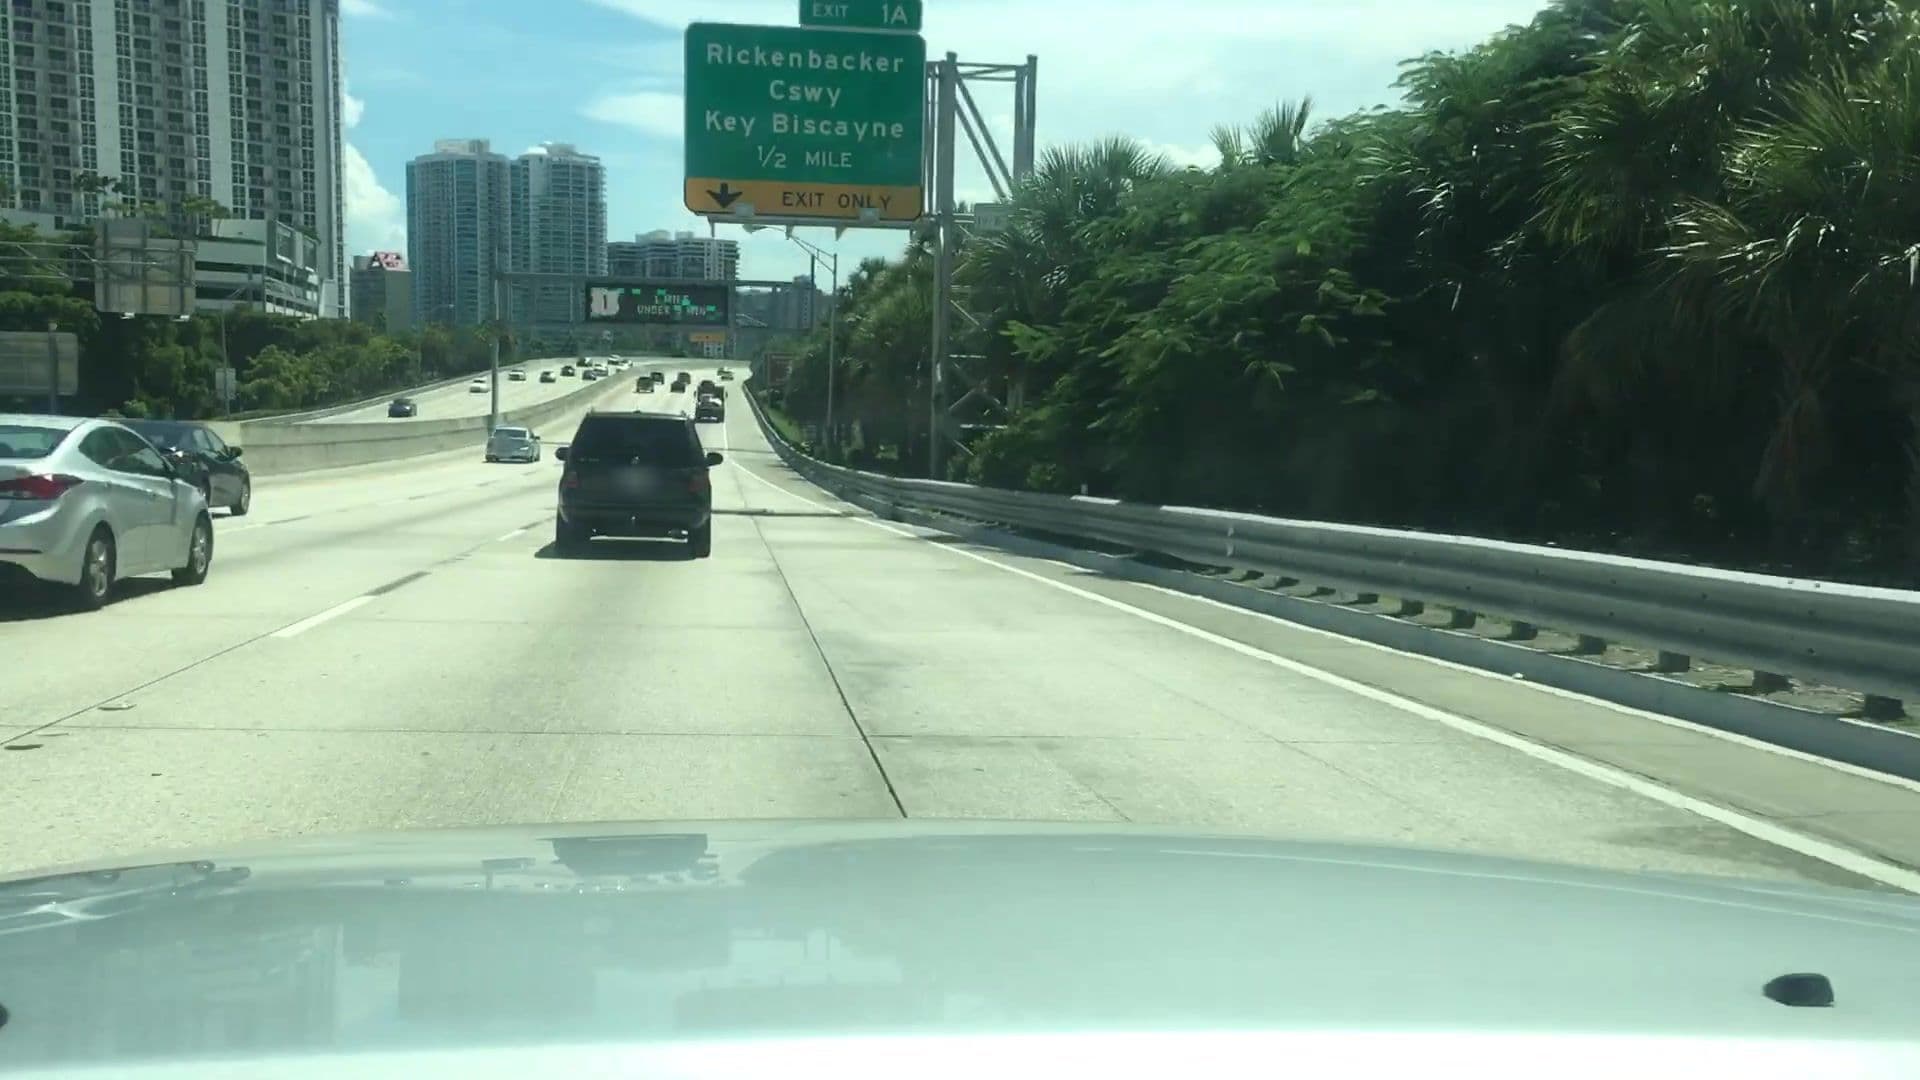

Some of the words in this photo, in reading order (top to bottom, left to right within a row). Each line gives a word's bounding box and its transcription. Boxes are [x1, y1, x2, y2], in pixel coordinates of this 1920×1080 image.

[813, 3, 849, 17] EXIT
[882, 3, 908, 24] 1A
[706, 43, 904, 73] Rickenbacker
[769, 80, 841, 107] Cswy
[705, 110, 756, 137] Key
[772, 113, 904, 142] Biscayne
[805, 151, 852, 168] MILE
[782, 191, 825, 208] EXIT
[838, 193, 892, 212] ONLY
